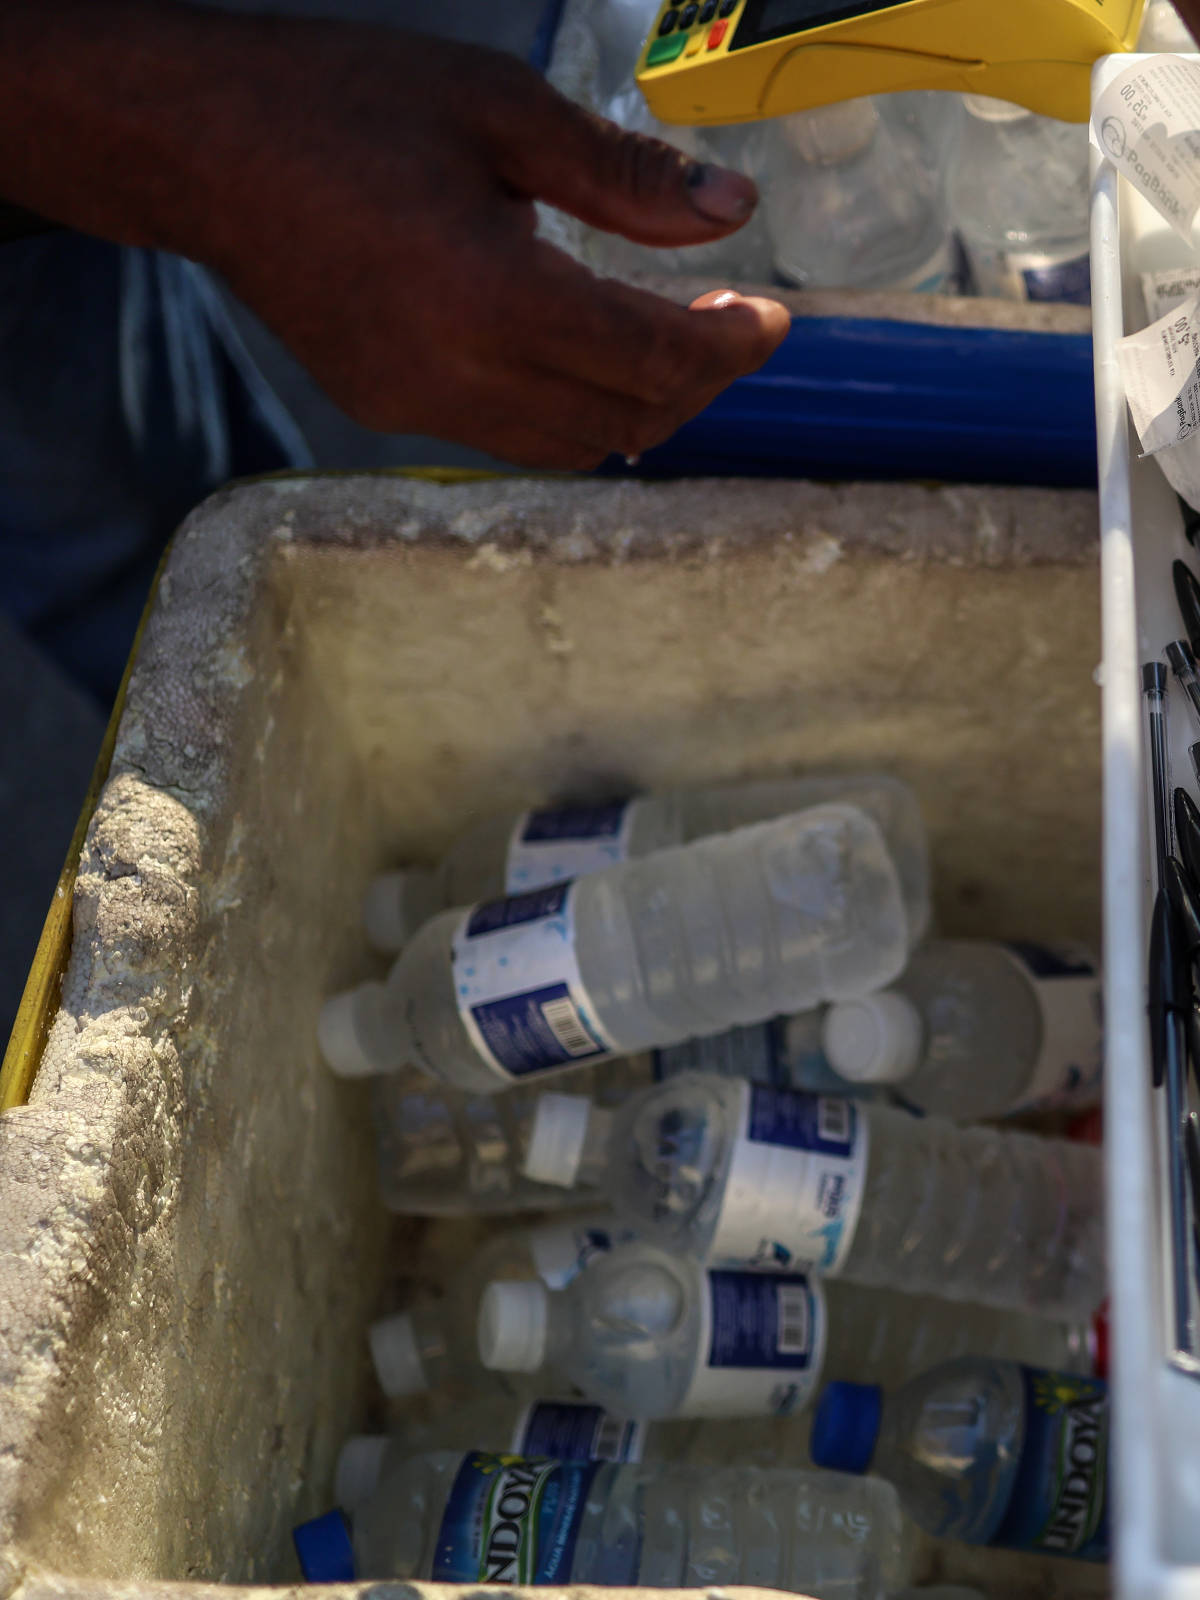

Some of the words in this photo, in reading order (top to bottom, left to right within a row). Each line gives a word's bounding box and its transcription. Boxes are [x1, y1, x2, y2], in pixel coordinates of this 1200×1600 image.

[1127, 149, 1181, 215] PagBank
[1175, 395, 1189, 428] PagBank
[484, 1462, 538, 1583] NDOYA
